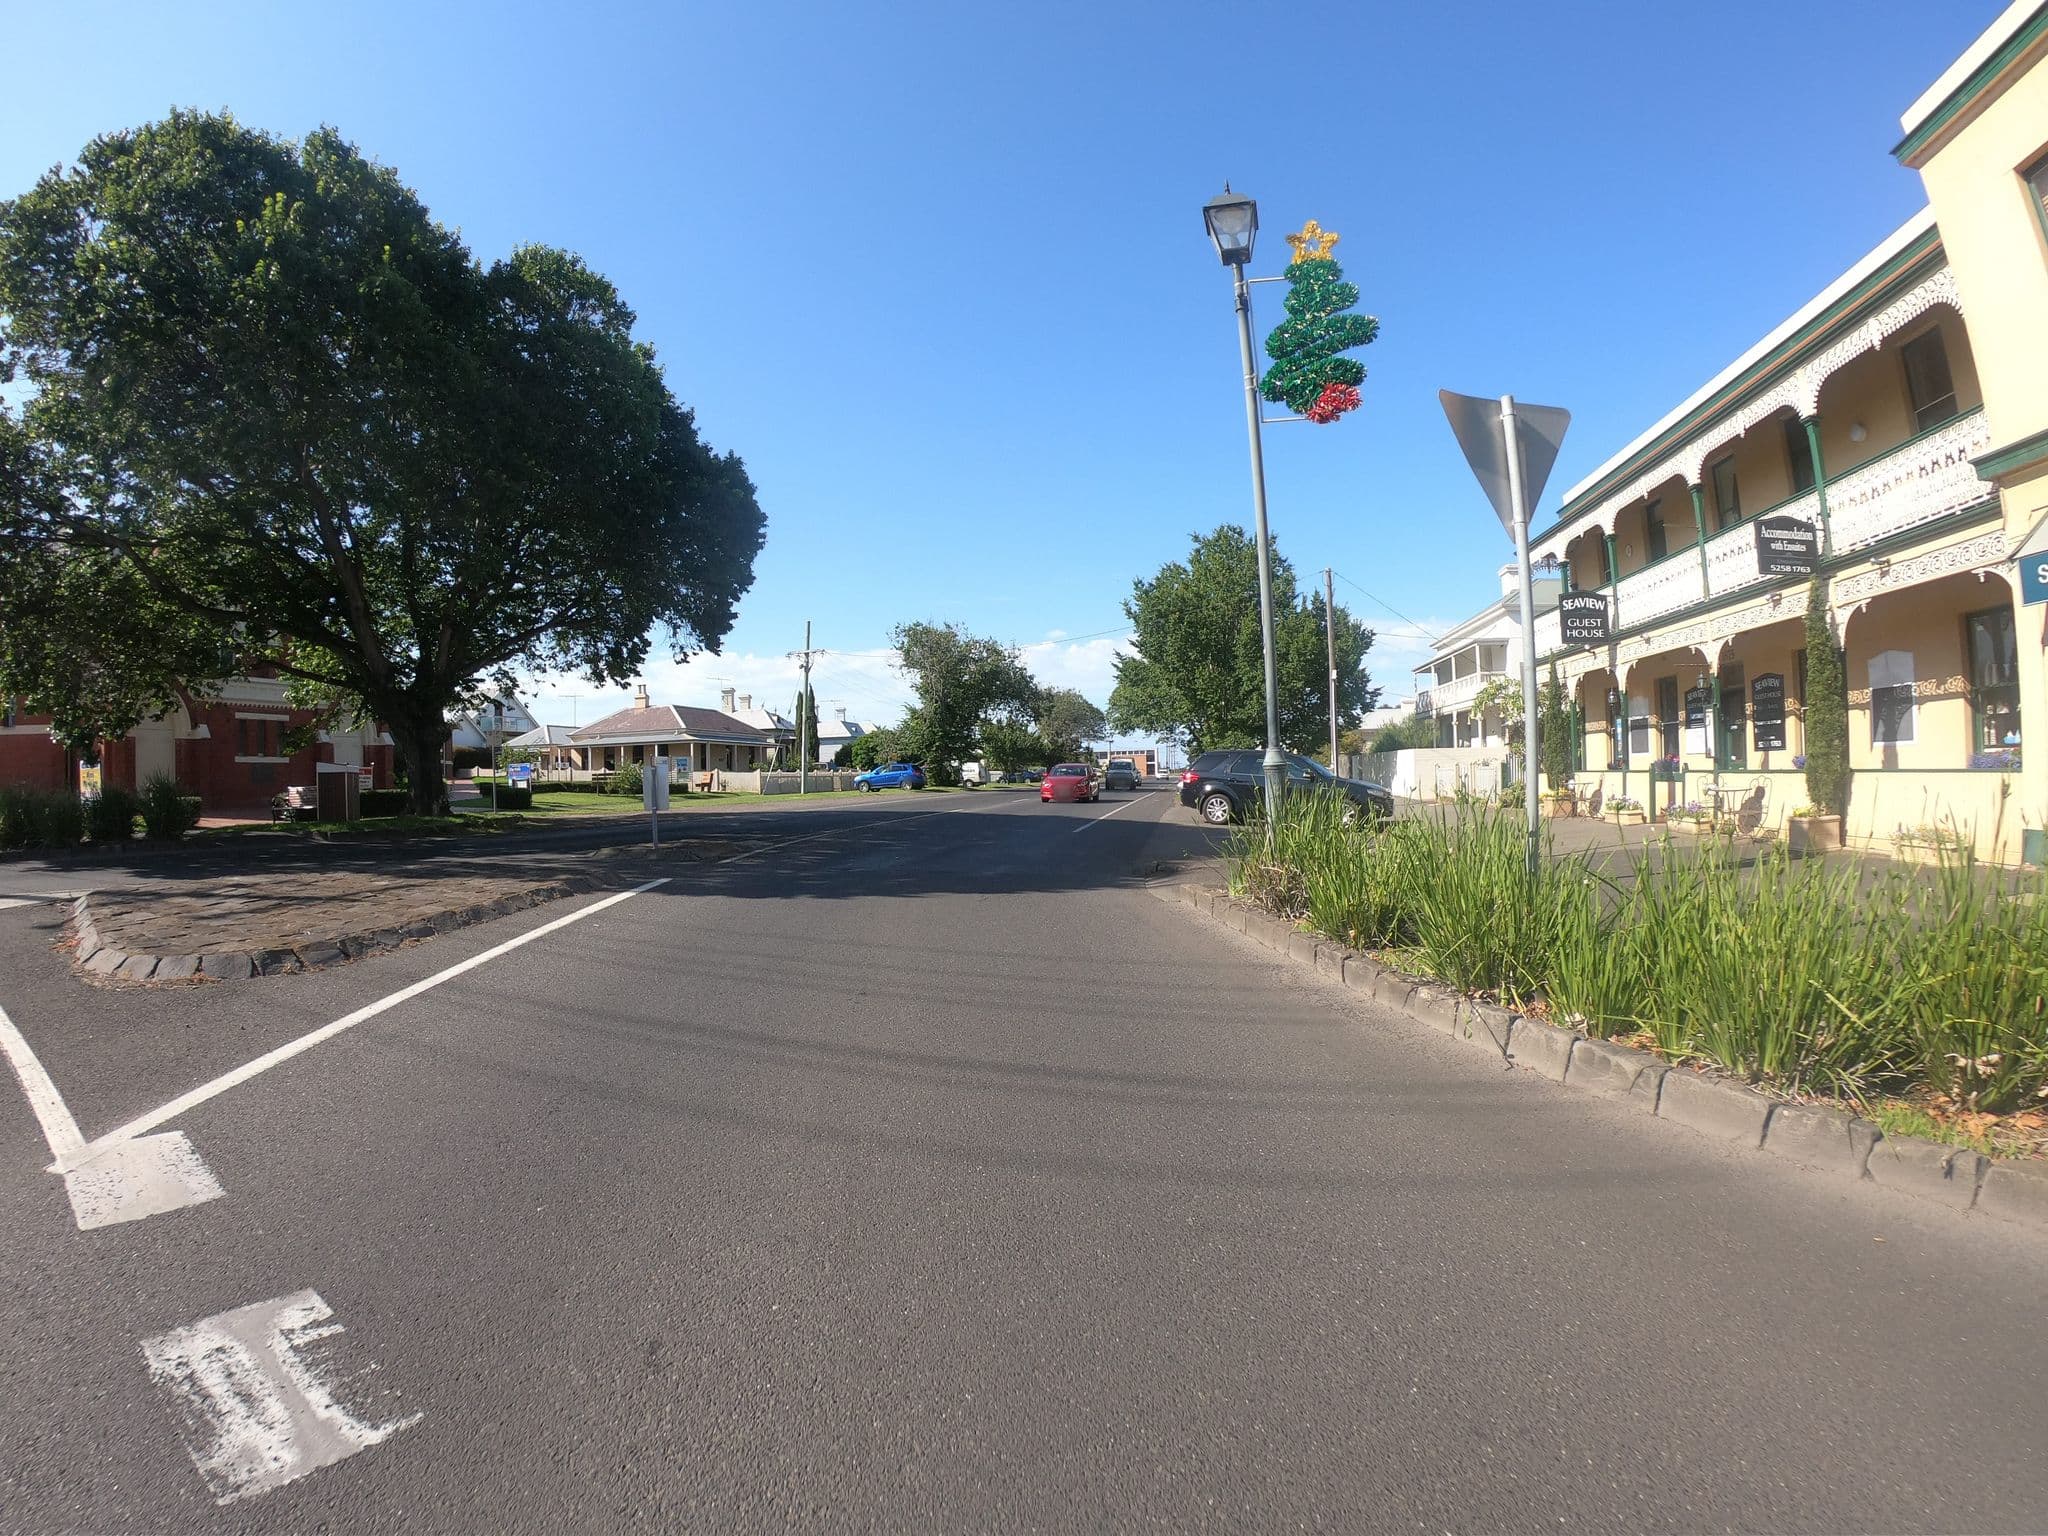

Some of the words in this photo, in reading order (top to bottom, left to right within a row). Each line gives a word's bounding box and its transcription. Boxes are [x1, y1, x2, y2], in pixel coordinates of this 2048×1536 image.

[1760, 525, 1813, 540] Accommodation
[1770, 540, 1783, 550] with
[1783, 541, 1806, 551] Ensuites
[1562, 597, 1605, 611] SEAVIEW
[1567, 618, 1602, 627] GUEST
[1566, 629, 1605, 638] HOUSE
